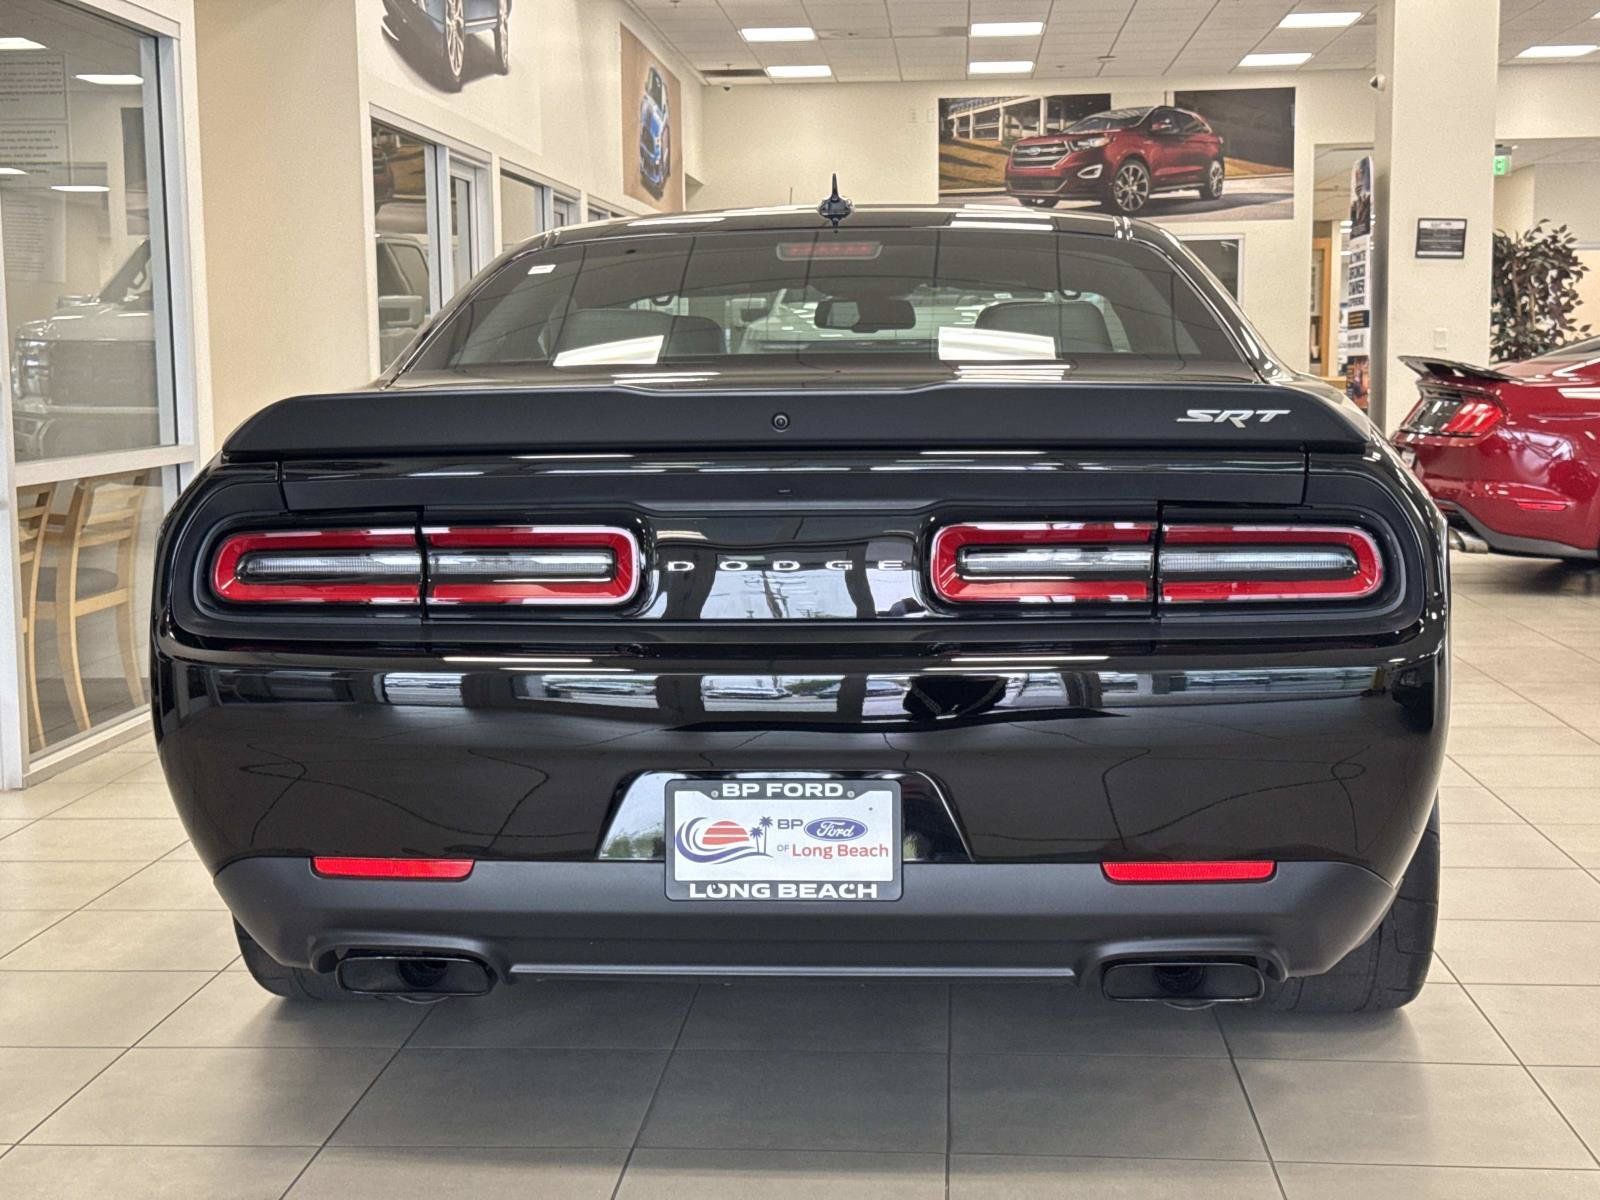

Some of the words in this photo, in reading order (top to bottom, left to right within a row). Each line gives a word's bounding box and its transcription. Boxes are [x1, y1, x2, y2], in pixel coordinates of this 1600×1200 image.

[1176, 409, 1291, 428] SRT
[667, 560, 907, 571] DODGE
[722, 783, 760, 797] BP
[766, 783, 843, 797] FORD
[777, 819, 804, 830] BP
[816, 820, 855, 837] Ford
[776, 844, 790, 853] OF
[792, 844, 833, 859] Long
[837, 843, 889, 857] Beach
[689, 883, 770, 899] LONG
[778, 883, 877, 899] BEACH
